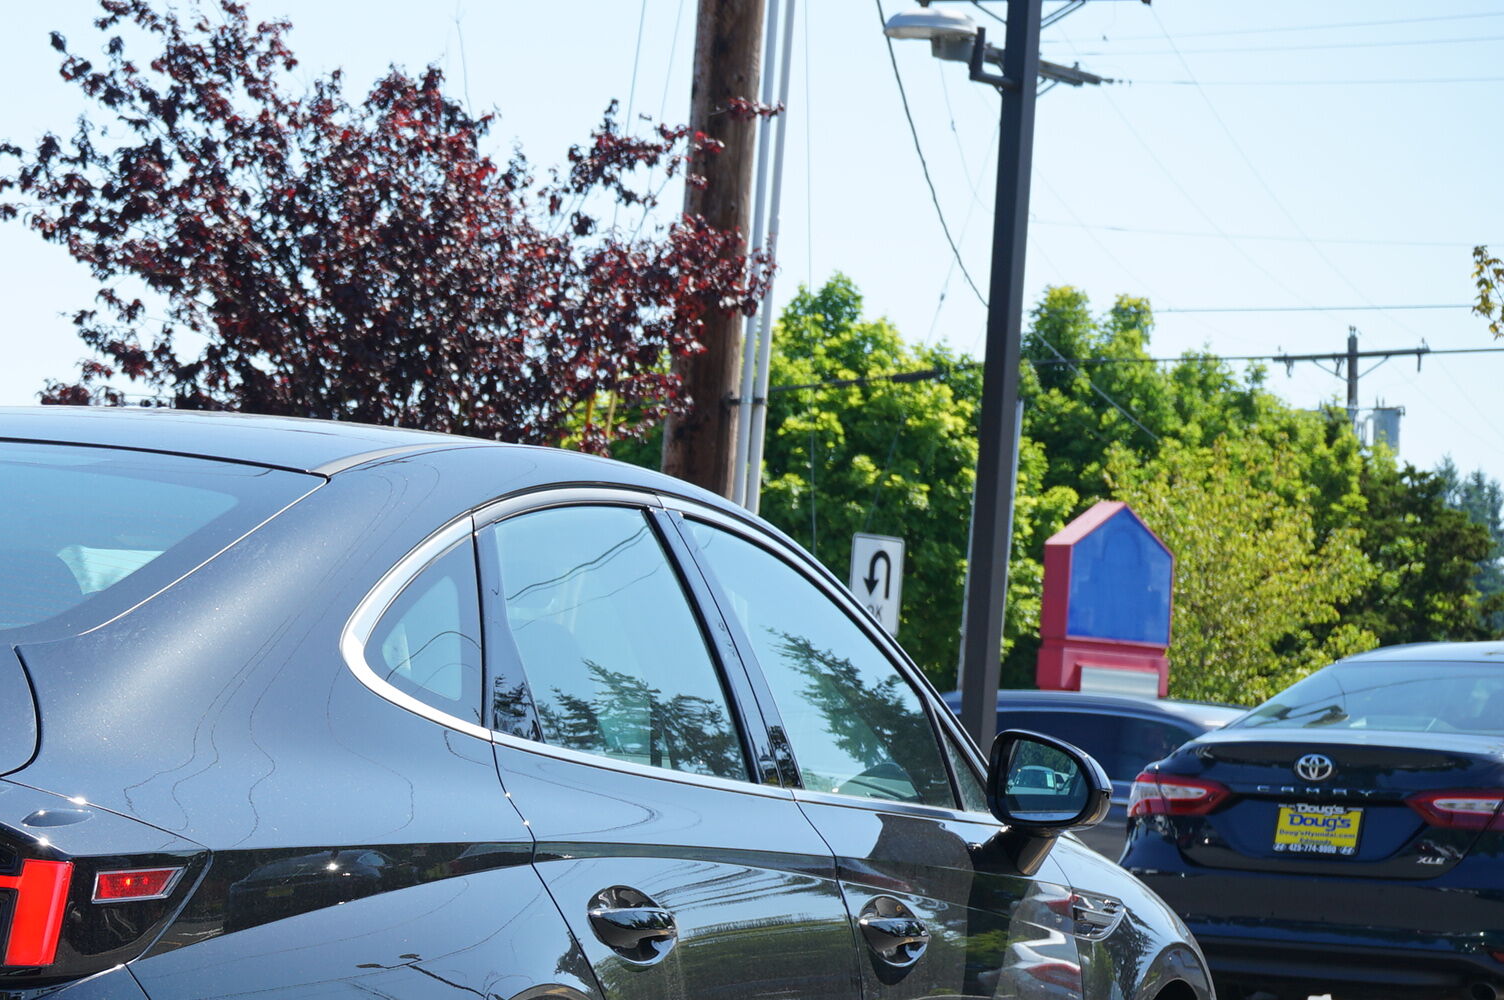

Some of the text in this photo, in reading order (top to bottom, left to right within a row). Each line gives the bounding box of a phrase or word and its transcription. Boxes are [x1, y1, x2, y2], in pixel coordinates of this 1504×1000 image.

[1296, 803, 1346, 816] Doug's
[1288, 814, 1351, 832] Doug's
[1416, 856, 1445, 865] XLE
